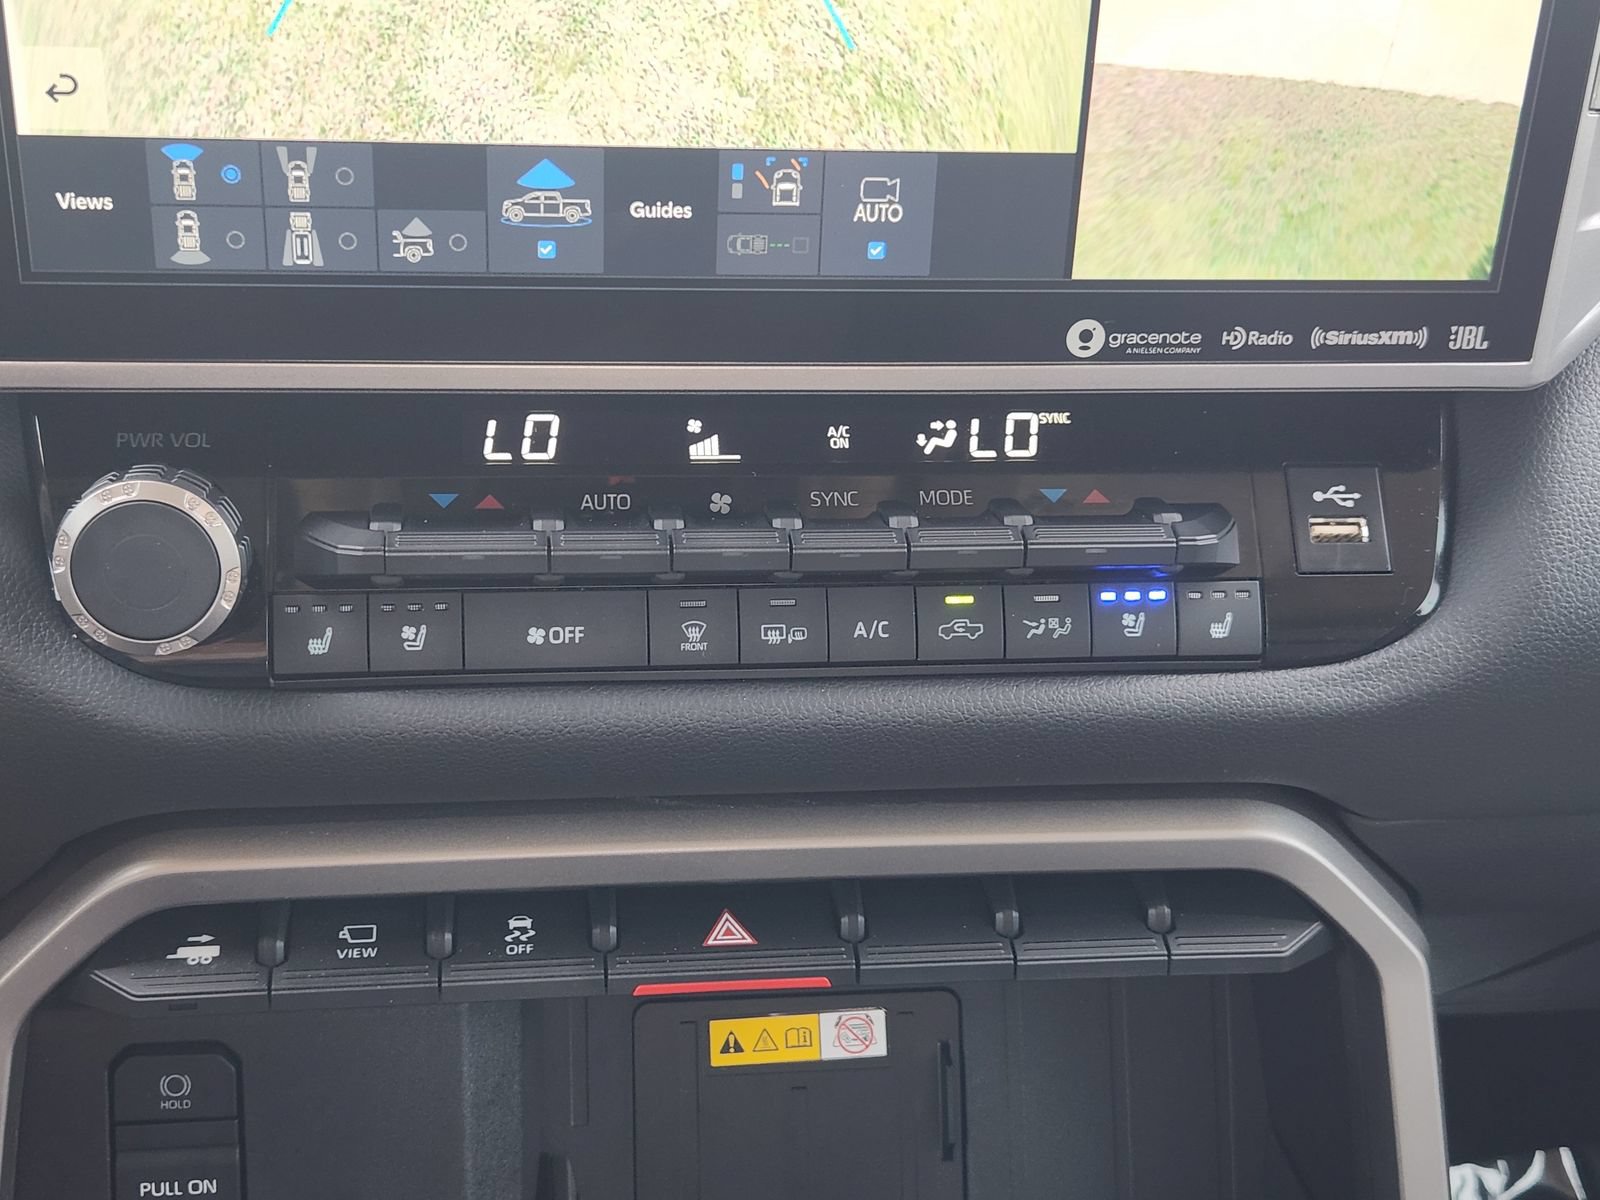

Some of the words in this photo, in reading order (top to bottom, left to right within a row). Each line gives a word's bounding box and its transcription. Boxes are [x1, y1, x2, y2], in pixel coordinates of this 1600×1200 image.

[54, 191, 114, 211] Views
[629, 200, 693, 219] Guides
[853, 203, 904, 224] AUTO
[1108, 331, 1202, 348] gracenote
[1221, 327, 1248, 350] HD
[1247, 330, 1294, 347] Radio
[1449, 325, 1489, 350] JBL
[1038, 412, 1072, 425] SYNC
[482, 412, 561, 462] LO
[826, 424, 850, 437] A/C
[968, 411, 1039, 459] LO
[116, 432, 164, 448] PWR
[170, 432, 211, 448] VOL
[828, 436, 850, 449] ON
[580, 493, 631, 510] AUTO
[810, 490, 859, 507] SYNC
[919, 489, 974, 506] MODE
[548, 626, 585, 644] OFF
[853, 619, 890, 640] A/C
[680, 640, 708, 650] FRONT
[336, 947, 378, 959] VIEW
[505, 939, 534, 954] OFF
[160, 1099, 192, 1110] HOLD
[139, 1181, 183, 1197] PULL
[187, 1179, 217, 1195] ON
